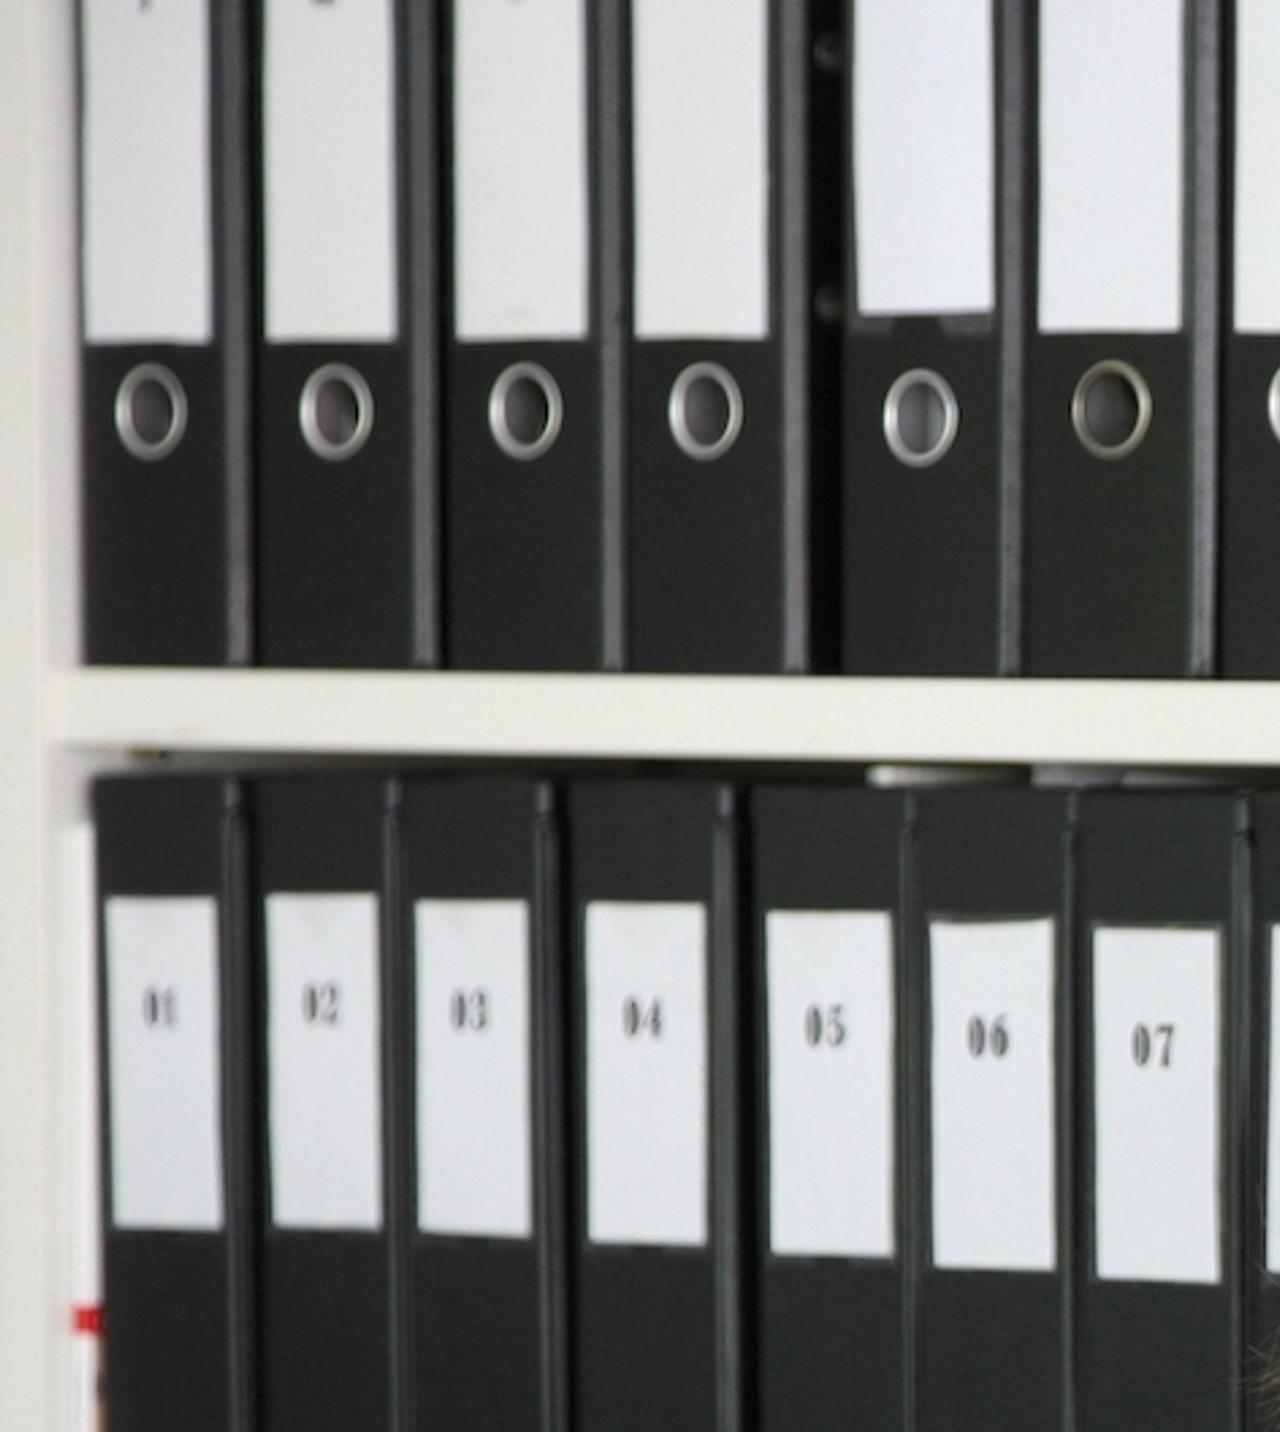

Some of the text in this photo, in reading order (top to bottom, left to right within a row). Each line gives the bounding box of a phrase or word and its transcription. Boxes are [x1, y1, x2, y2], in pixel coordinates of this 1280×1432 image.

[301, 983, 340, 1026] 02
[449, 989, 489, 1032] 03
[622, 996, 663, 1039] 04
[804, 1004, 847, 1048] 05
[967, 1015, 1011, 1059] 06
[1131, 1023, 1176, 1069] 07
